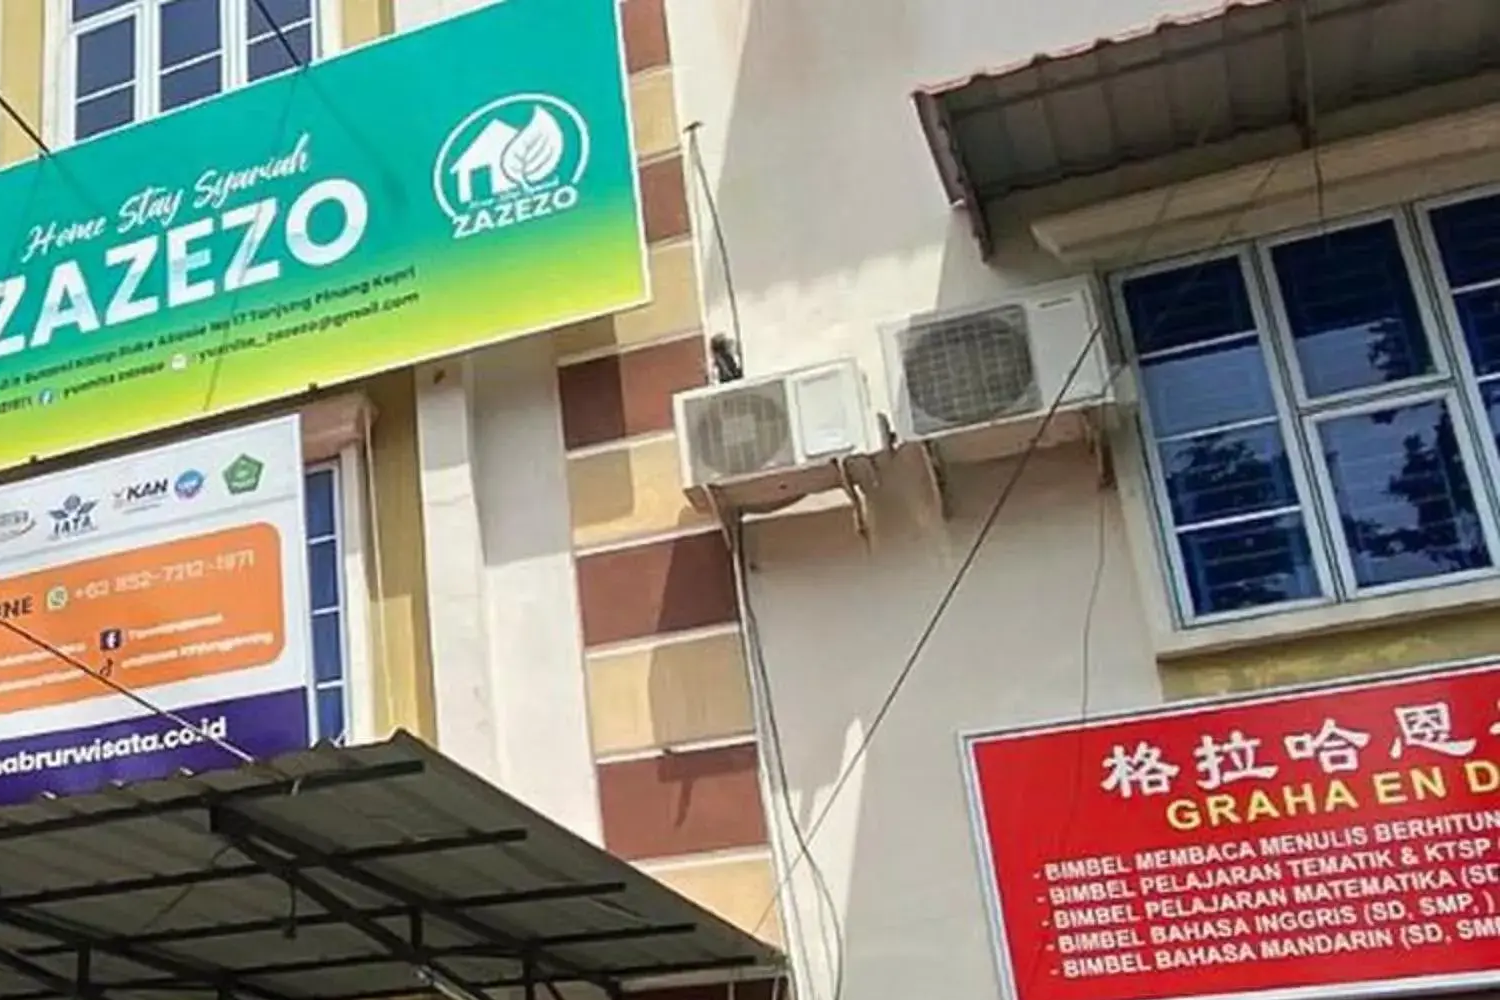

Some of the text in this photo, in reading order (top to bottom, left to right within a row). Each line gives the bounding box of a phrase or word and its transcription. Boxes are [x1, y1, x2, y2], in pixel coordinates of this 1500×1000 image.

[21, 131, 311, 263] Home Stay Syariah
[452, 185, 578, 240] ZAZEZO
[126, 478, 169, 501] KAN
[1101, 701, 1500, 799] 格拉哈恩
[1166, 777, 1359, 831] GRAHA
[1373, 766, 1448, 806] EN
[1045, 855, 1132, 882] BIMBEL
[1135, 840, 1257, 871] MEMBACA
[1259, 826, 1369, 857] MENULIS
[1049, 879, 1137, 905] BIMBEL
[1140, 862, 1283, 896] PELAJARAN
[1287, 850, 1395, 879] TEMATIK
[1401, 847, 1419, 866] &
[1425, 838, 1491, 862] KTSP
[1054, 904, 1142, 930] BIMBEL
[1145, 887, 1289, 921] PELAJARAN
[1292, 868, 1457, 903] MATEMATIKA
[1058, 928, 1146, 954] BIMBEL
[1150, 916, 1251, 945] BAHASA
[1255, 905, 1358, 934] INGGRIS
[1062, 952, 1151, 979] BIMBEL
[1155, 941, 1257, 970] BAHASA
[1261, 927, 1394, 960] MANDARIN
